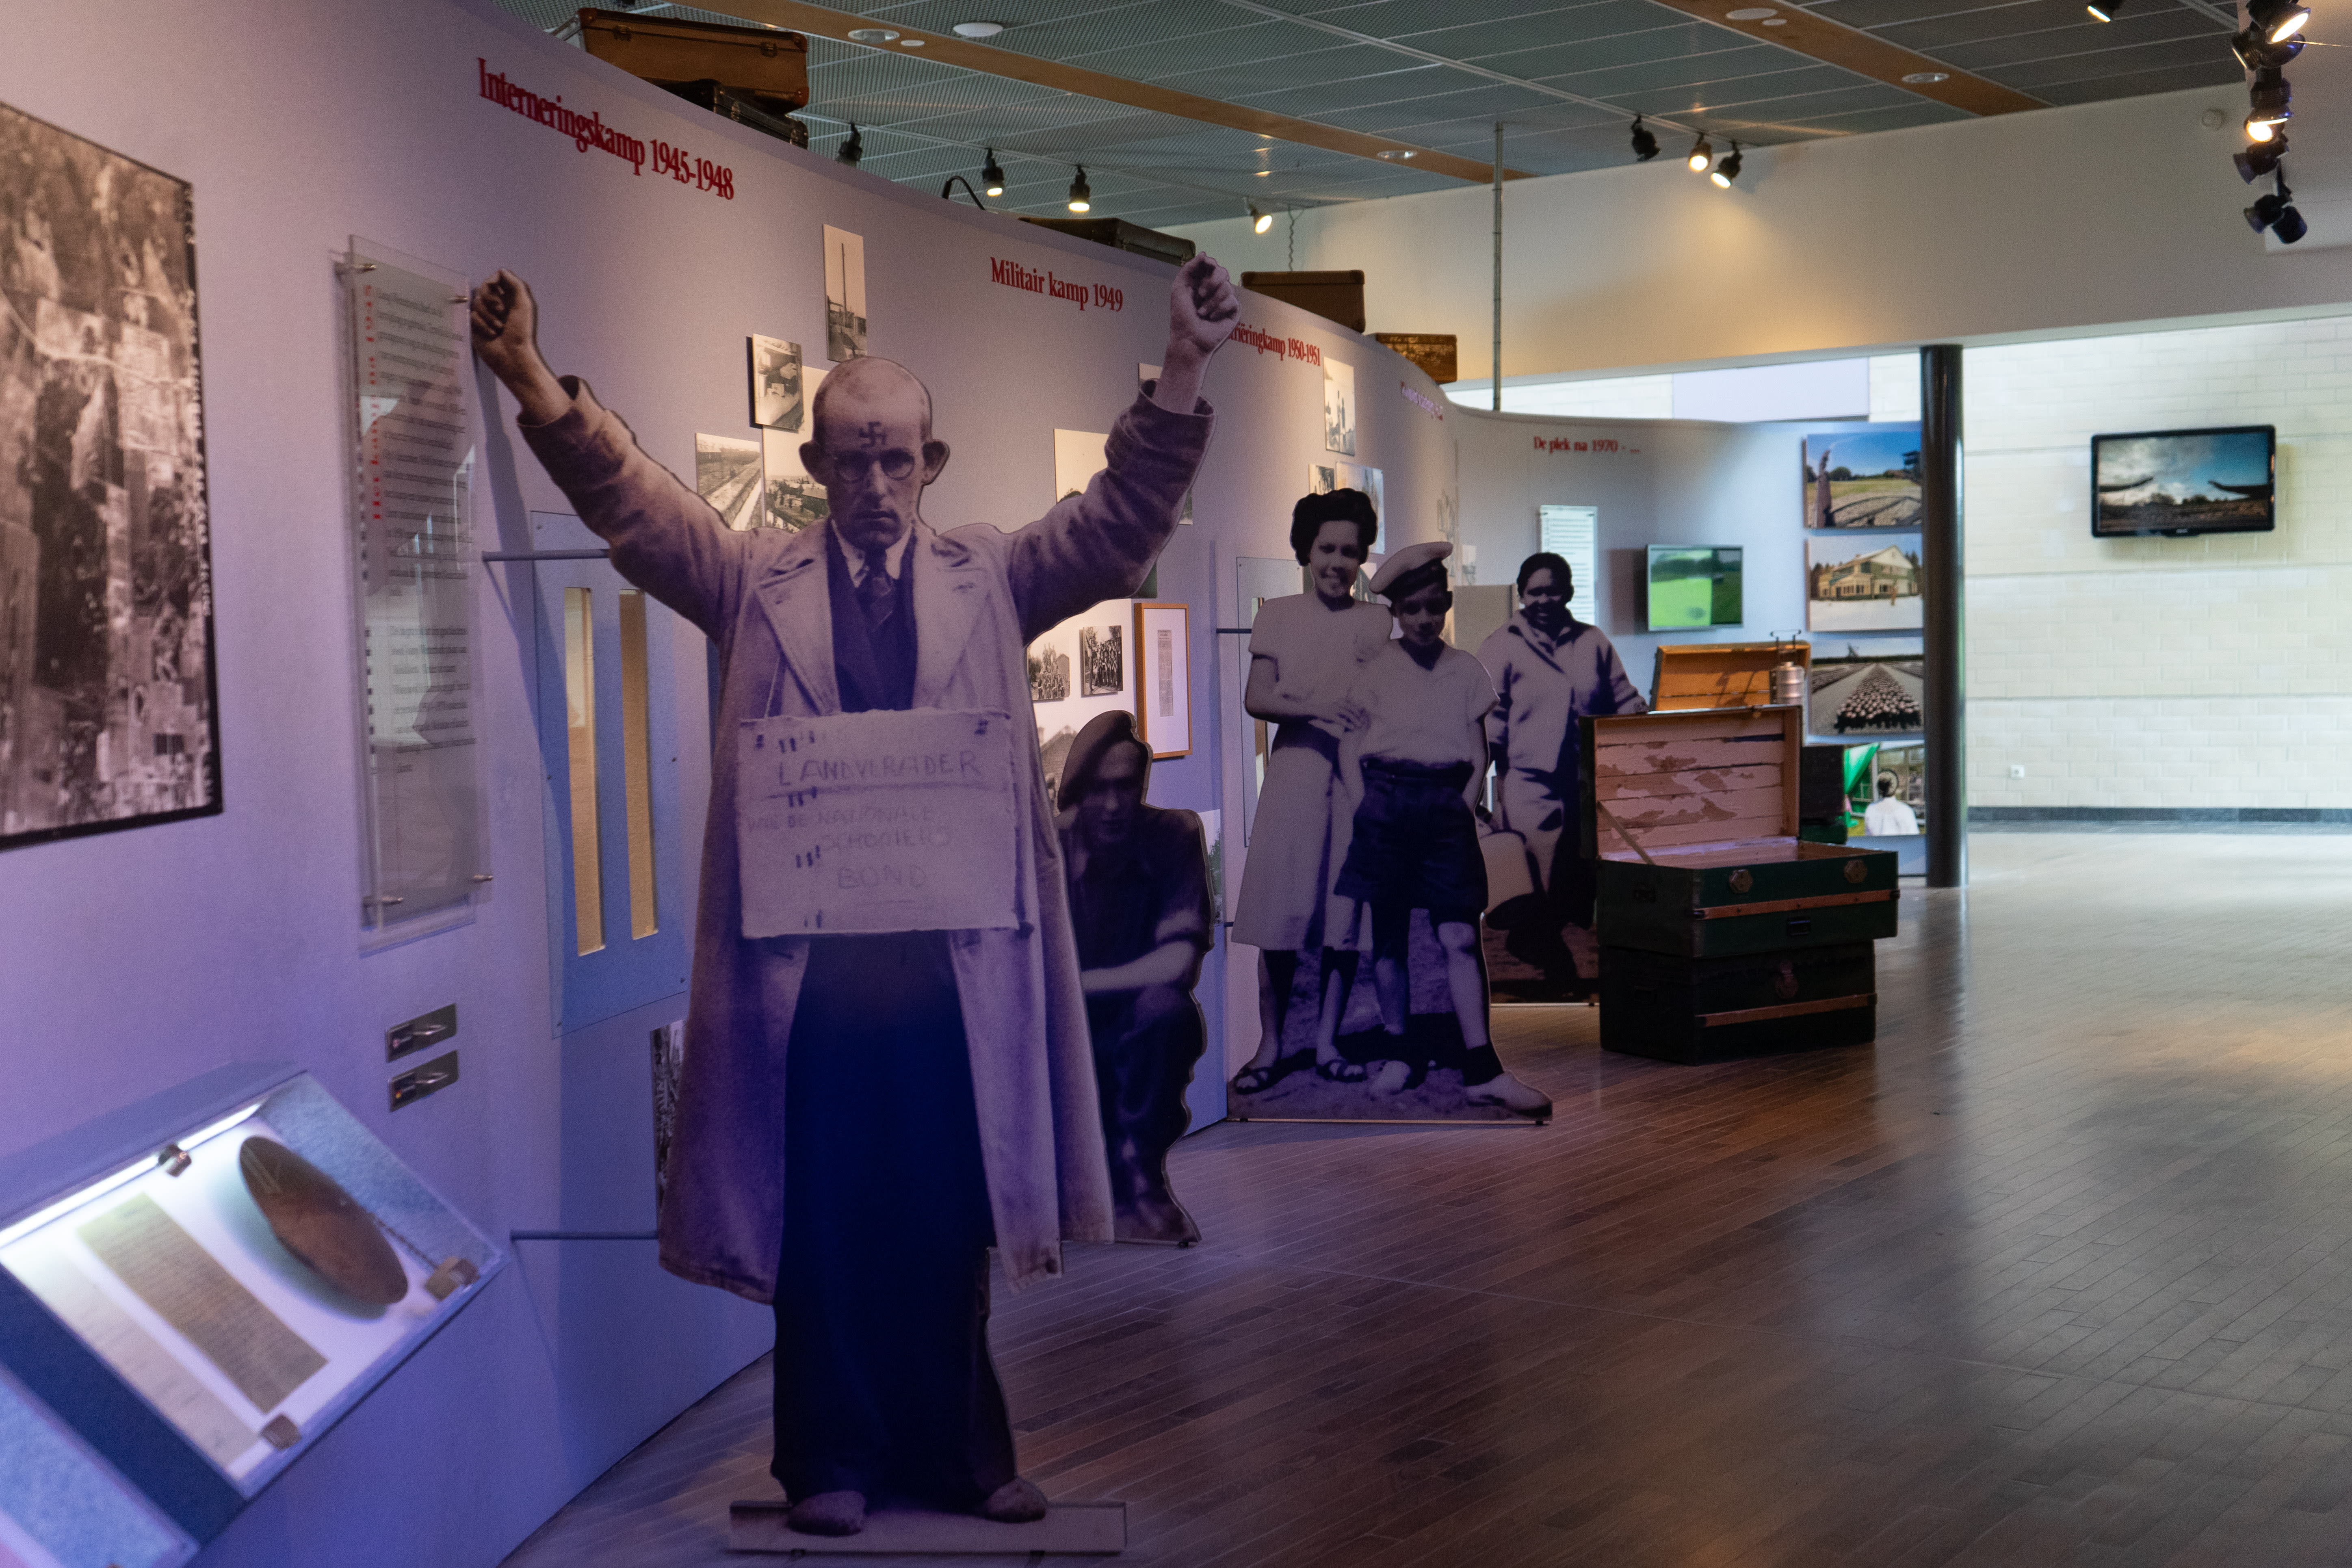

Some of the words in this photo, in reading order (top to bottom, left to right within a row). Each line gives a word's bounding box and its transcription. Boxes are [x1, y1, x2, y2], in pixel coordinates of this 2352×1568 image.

[478, 58, 645, 176] Interneringskamp
[650, 139, 734, 200] 1945-1948
[990, 256, 1045, 293] Militair
[1048, 271, 1089, 311] kamp
[1093, 284, 1123, 312] 1949
[1288, 338, 1321, 366] 1950-1951
[1534, 436, 1546, 449] De
[1549, 437, 1570, 454] plek
[1574, 441, 1588, 451] na
[1592, 439, 1618, 453] 1970
[837, 864, 927, 889] BOND
